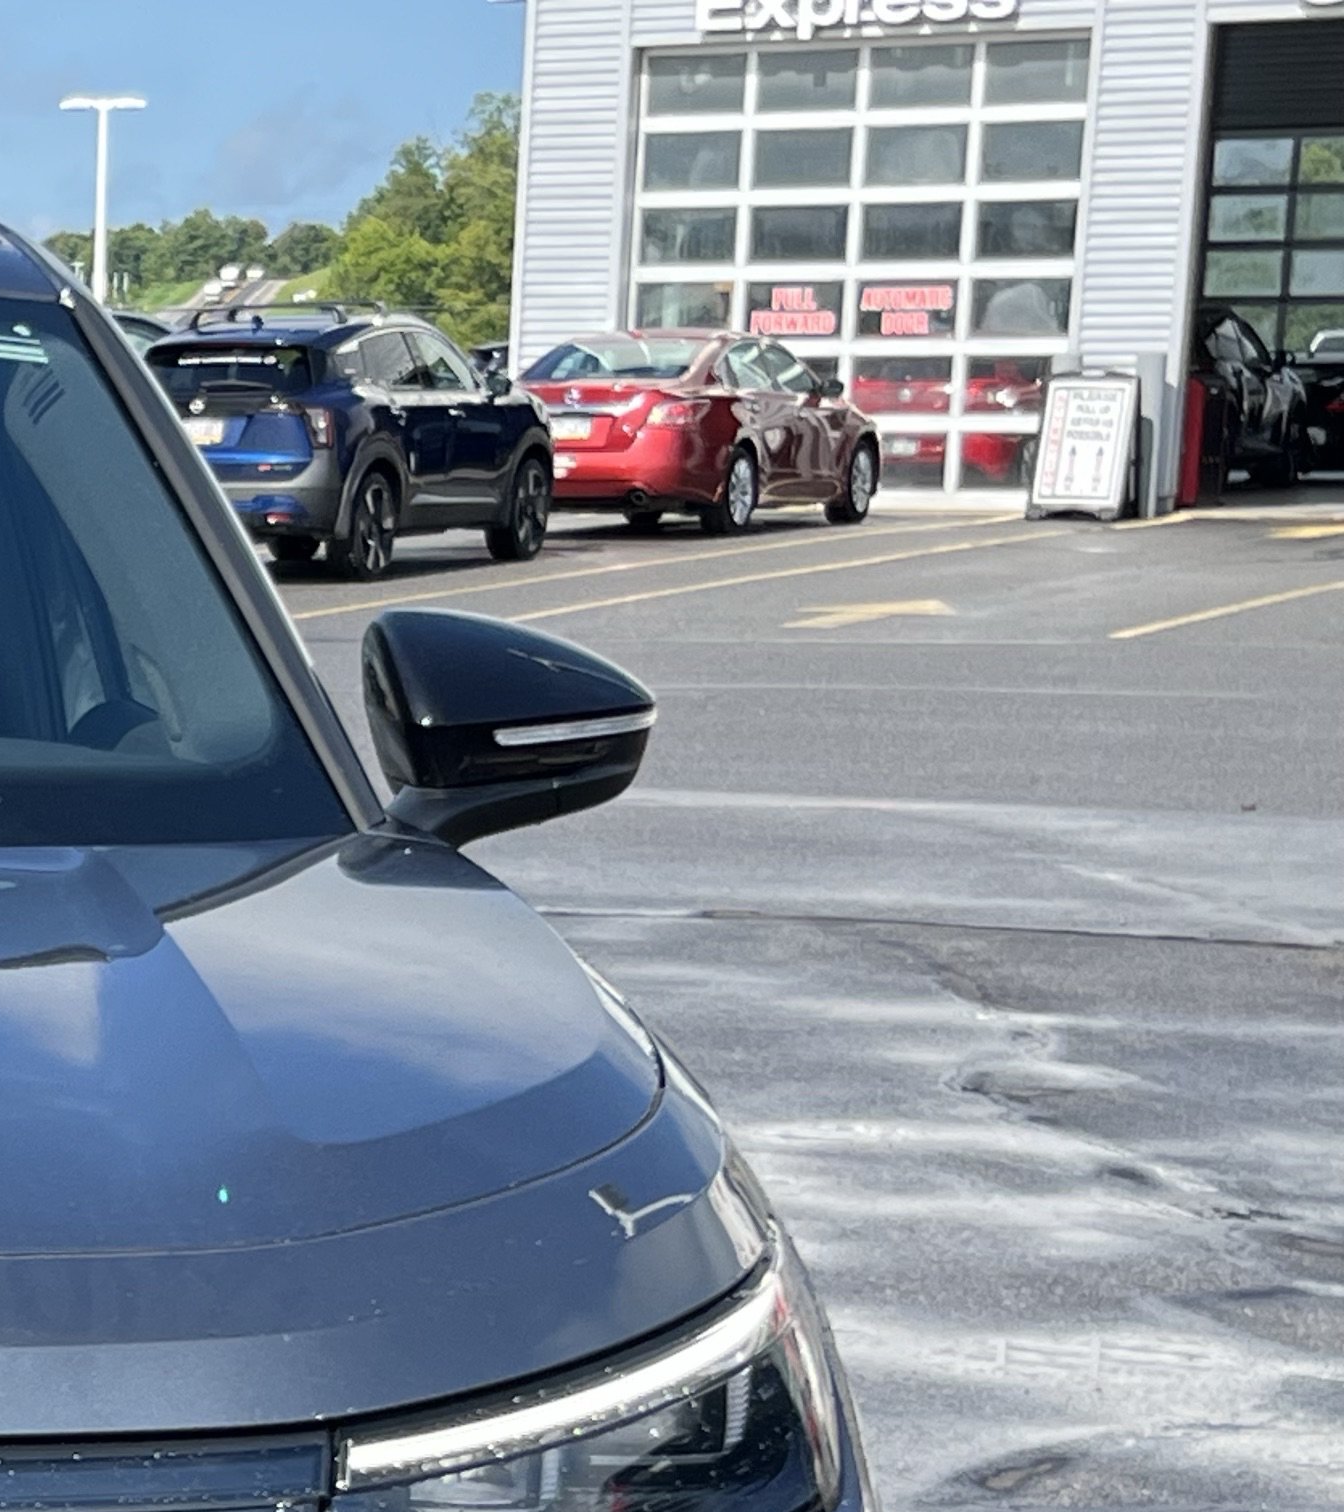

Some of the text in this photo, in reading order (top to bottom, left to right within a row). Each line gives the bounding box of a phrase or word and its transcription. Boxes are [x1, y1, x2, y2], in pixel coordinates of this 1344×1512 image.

[771, 287, 816, 311] PULL
[750, 310, 835, 335] FORWARD
[880, 311, 929, 336] DOOR
